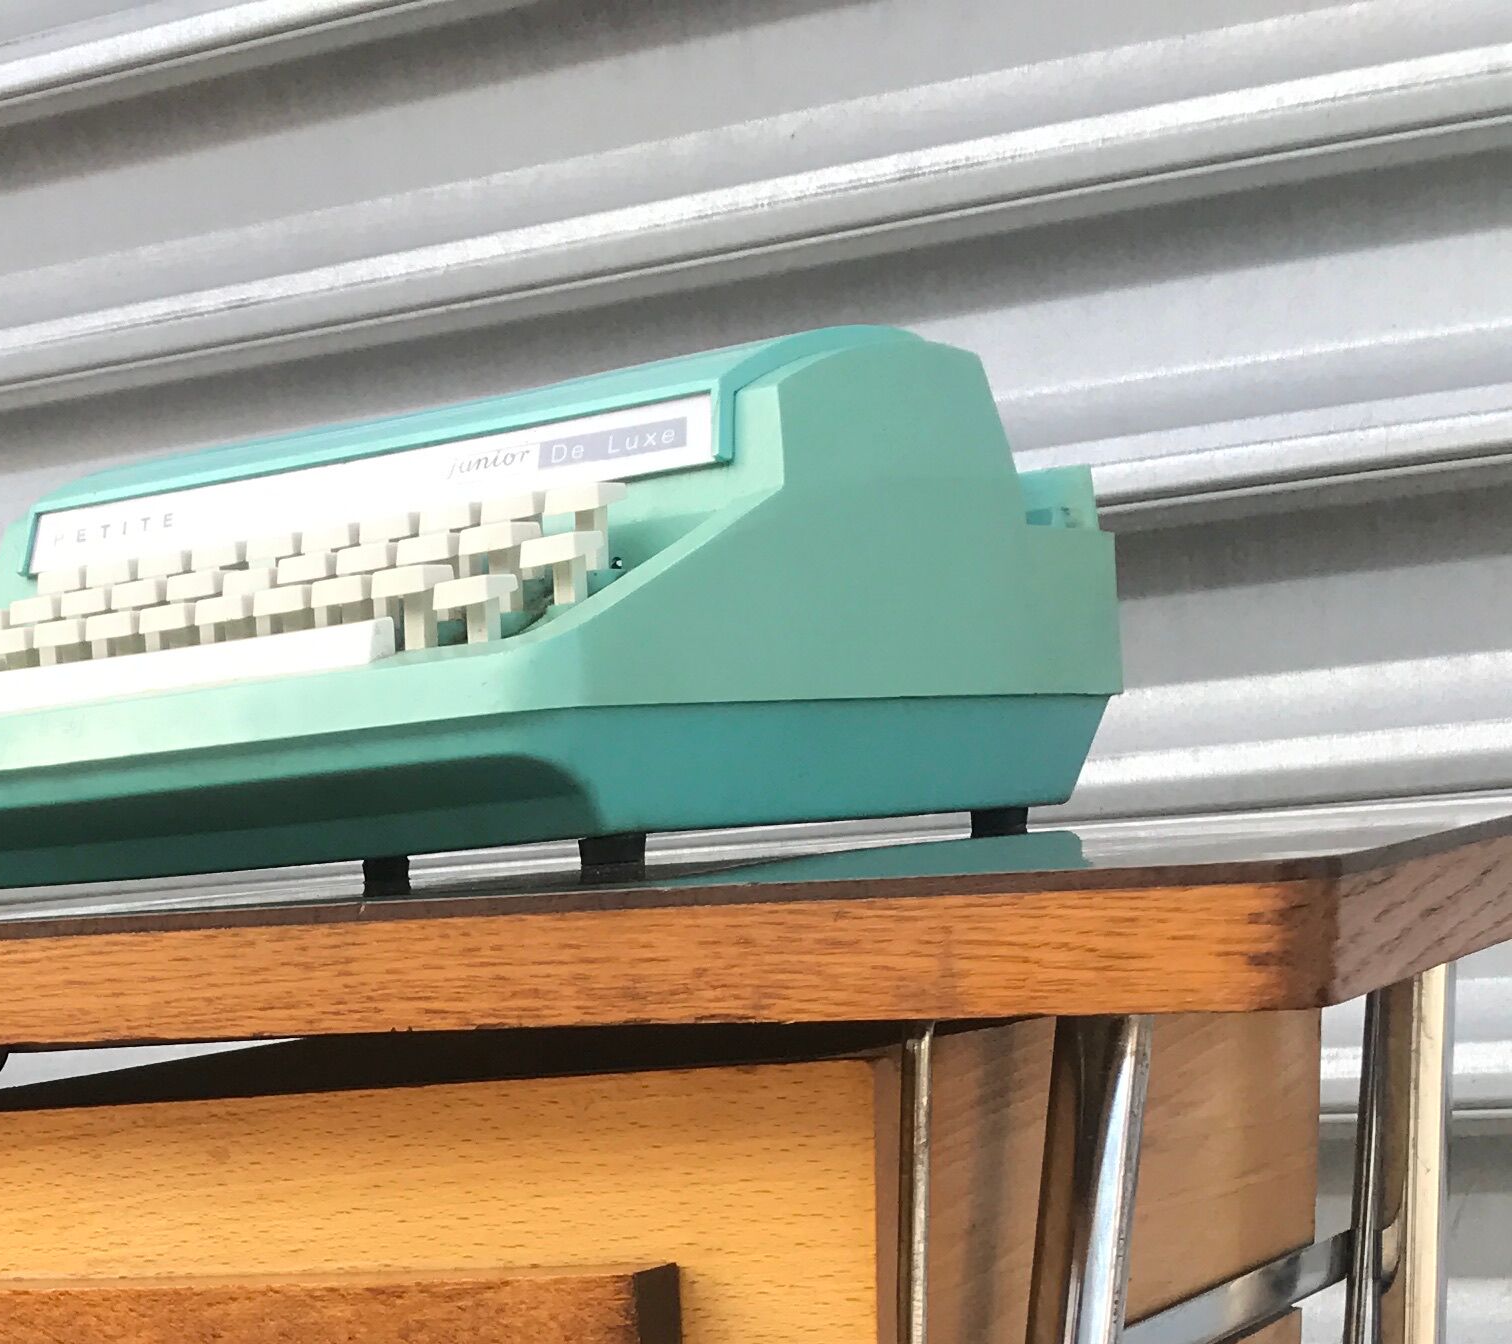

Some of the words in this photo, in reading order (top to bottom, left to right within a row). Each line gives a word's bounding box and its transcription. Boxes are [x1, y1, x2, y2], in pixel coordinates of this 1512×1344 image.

[447, 449, 531, 480] junior
[551, 443, 585, 464] De
[607, 427, 676, 455] Luxe
